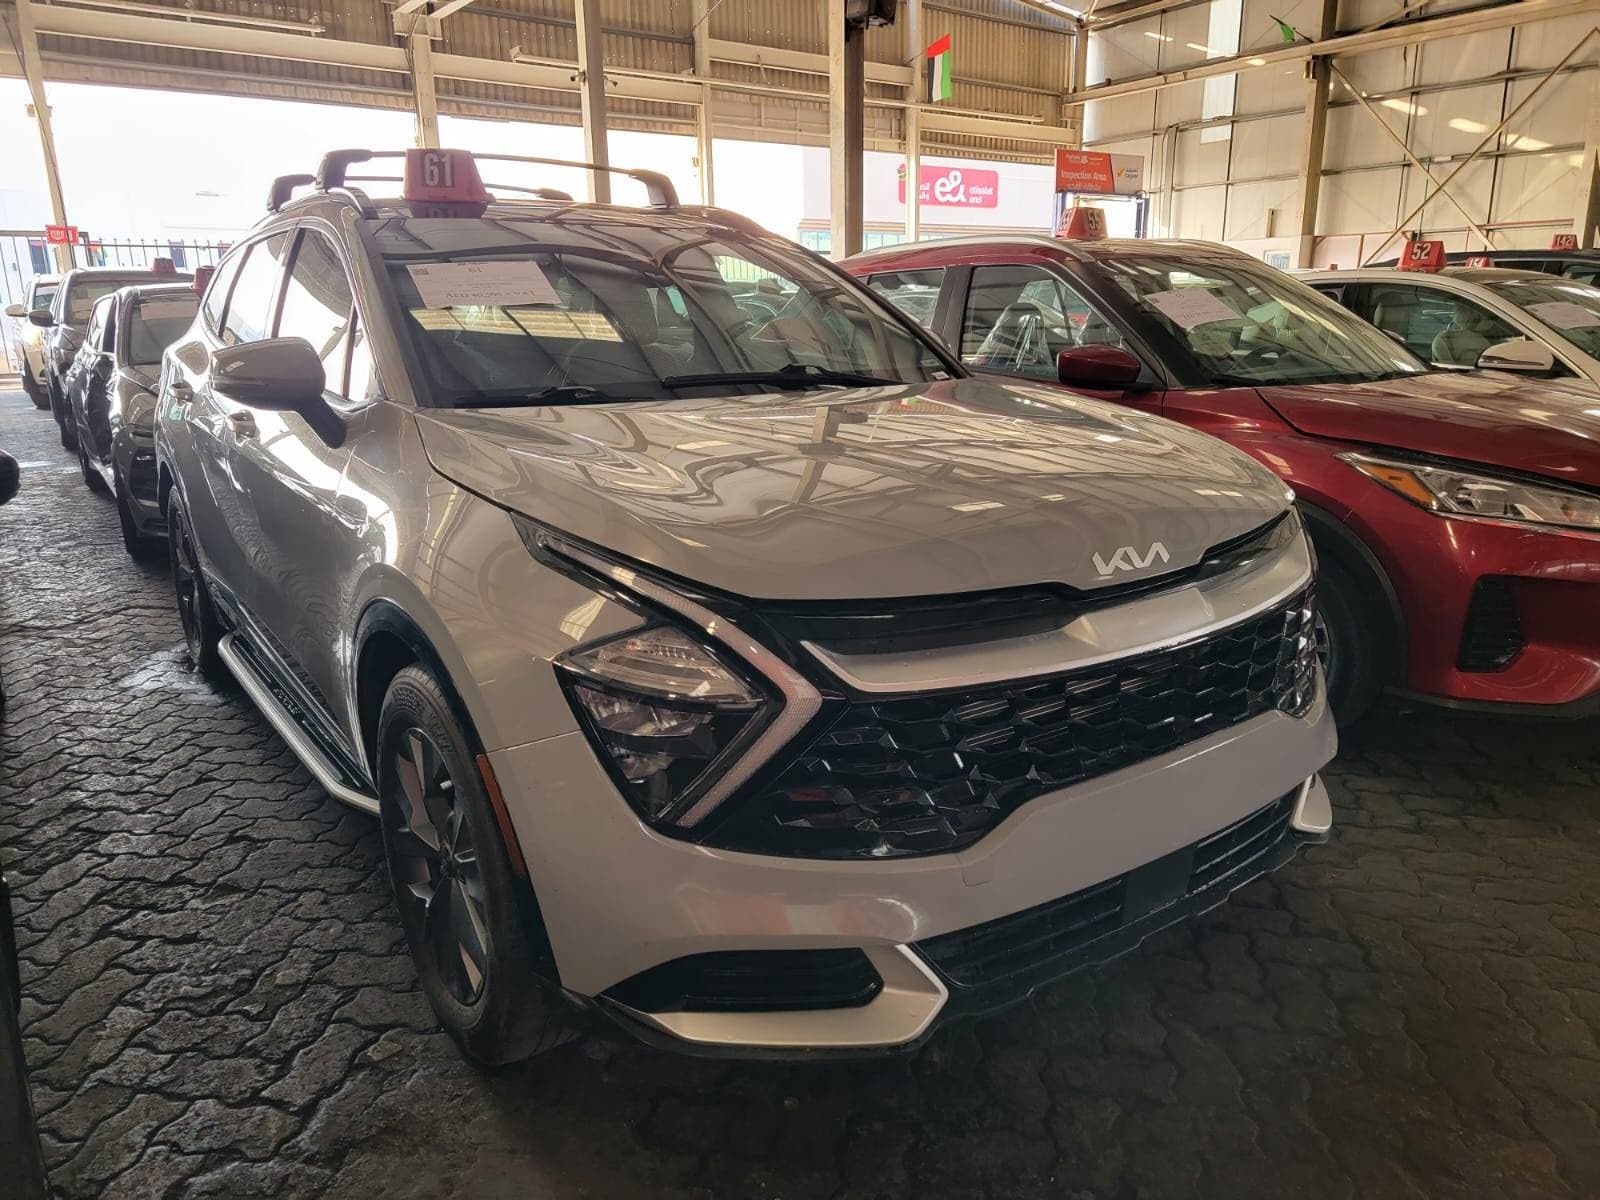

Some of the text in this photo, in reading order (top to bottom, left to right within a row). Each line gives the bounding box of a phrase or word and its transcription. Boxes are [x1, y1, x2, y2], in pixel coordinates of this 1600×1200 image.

[424, 152, 453, 187] 61
[1061, 169, 1107, 181] Inspection Area
[1087, 209, 1102, 230] 55
[1411, 243, 1431, 260] 52
